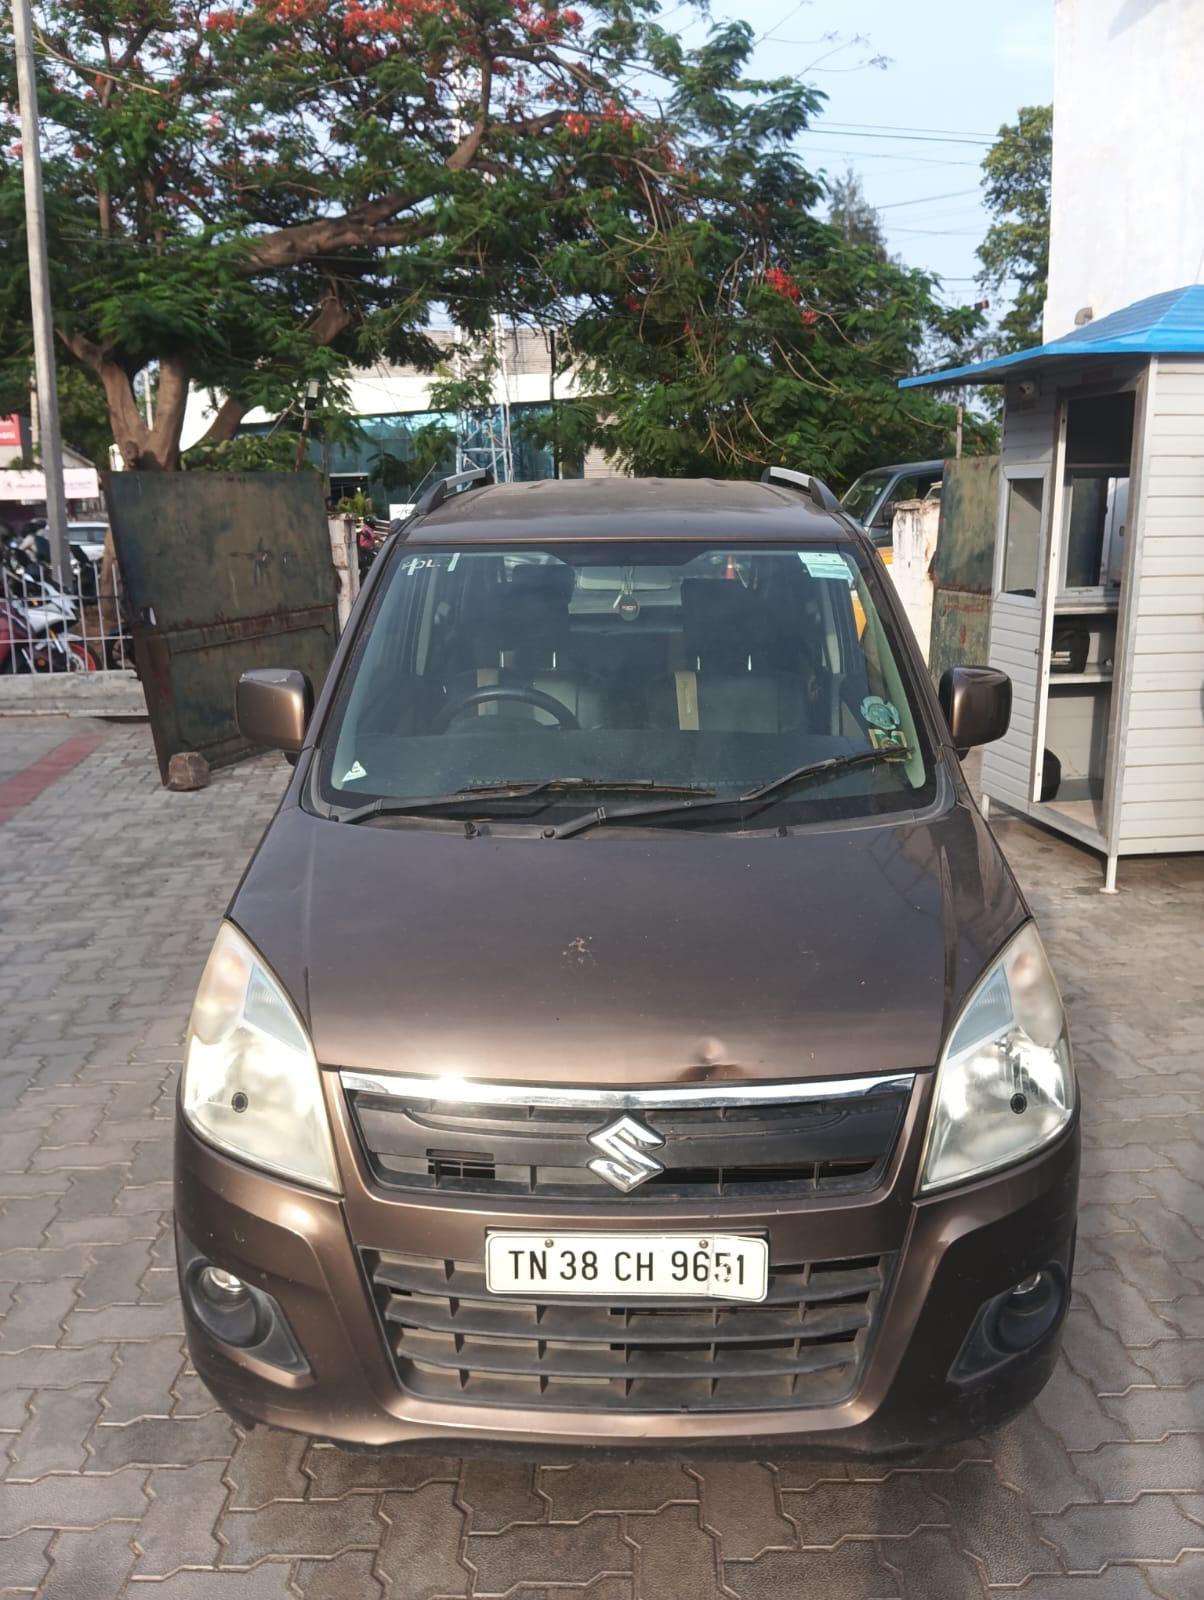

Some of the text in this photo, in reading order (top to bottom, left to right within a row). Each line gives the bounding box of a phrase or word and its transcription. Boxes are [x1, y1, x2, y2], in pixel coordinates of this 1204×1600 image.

[508, 1250, 744, 1285] TN 38 CH 9651
